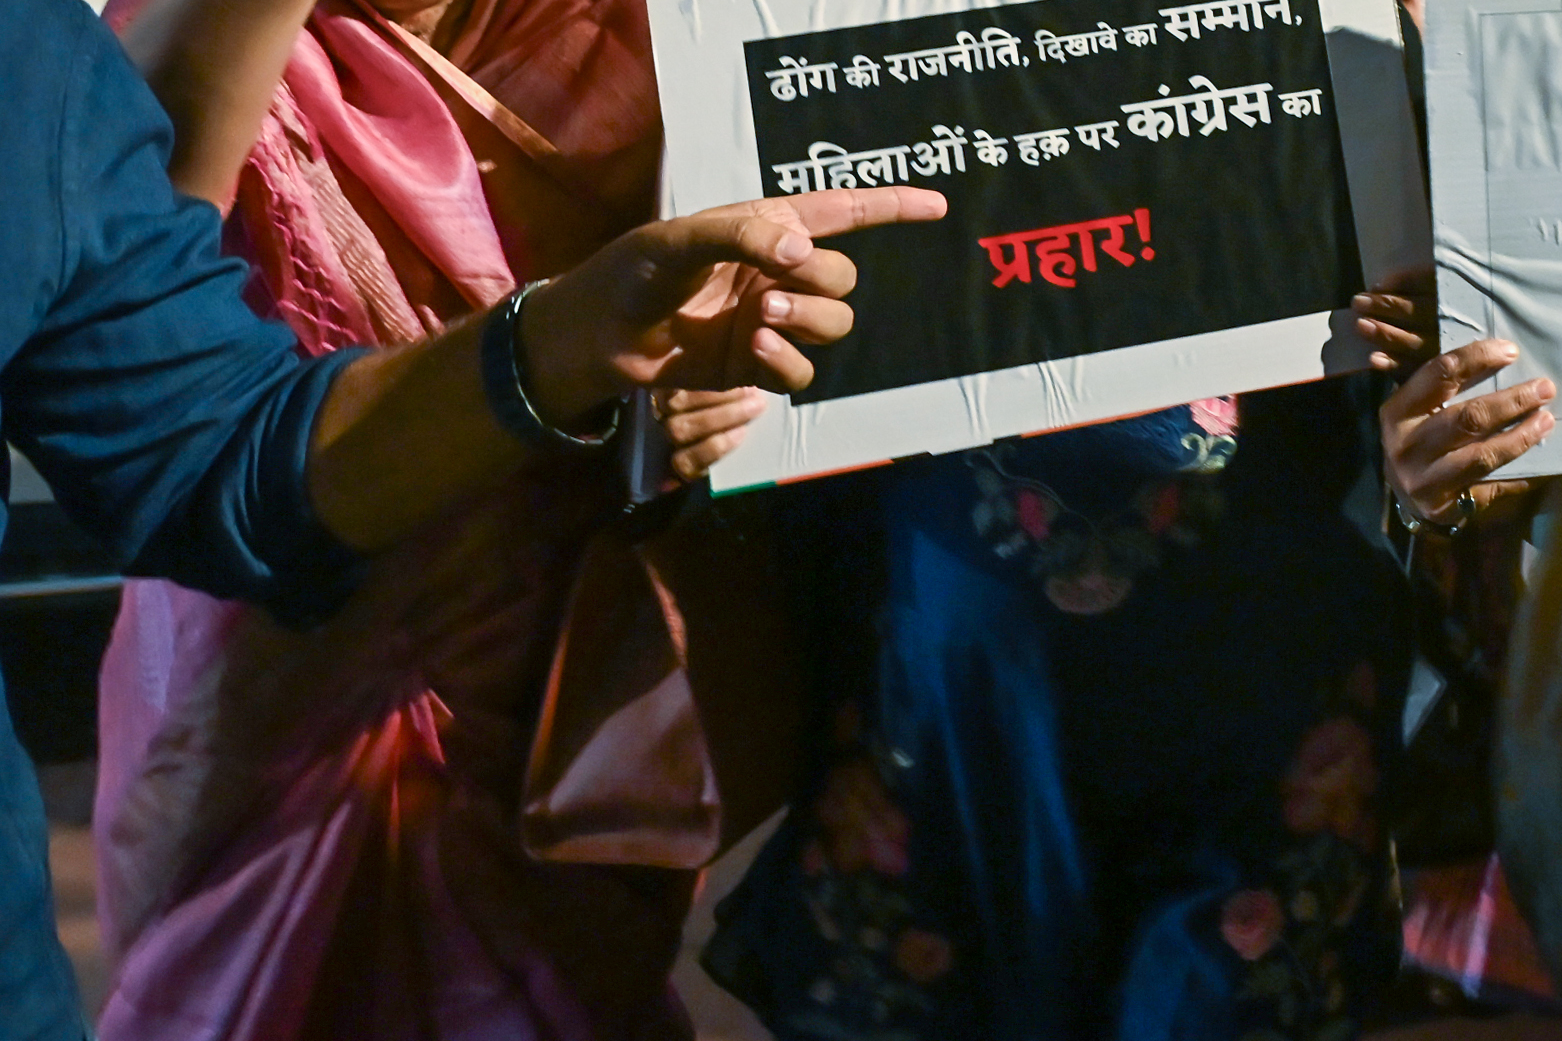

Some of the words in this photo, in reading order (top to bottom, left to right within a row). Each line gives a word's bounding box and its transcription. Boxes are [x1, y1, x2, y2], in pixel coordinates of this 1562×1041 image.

[765, 55, 838, 101] ढोंग
[844, 57, 880, 88] की
[885, 28, 1030, 84] राजनीति,
[1034, 22, 1118, 62] दिखावे
[1123, 23, 1157, 47] का
[772, 125, 969, 194] महिलाओं
[973, 130, 1009, 167] के
[1013, 126, 1070, 166] हक़
[1075, 121, 1120, 150] पर
[1122, 75, 1273, 142] कांग्रेस
[1279, 88, 1322, 118] का
[978, 208, 1155, 288] प्रहार!
